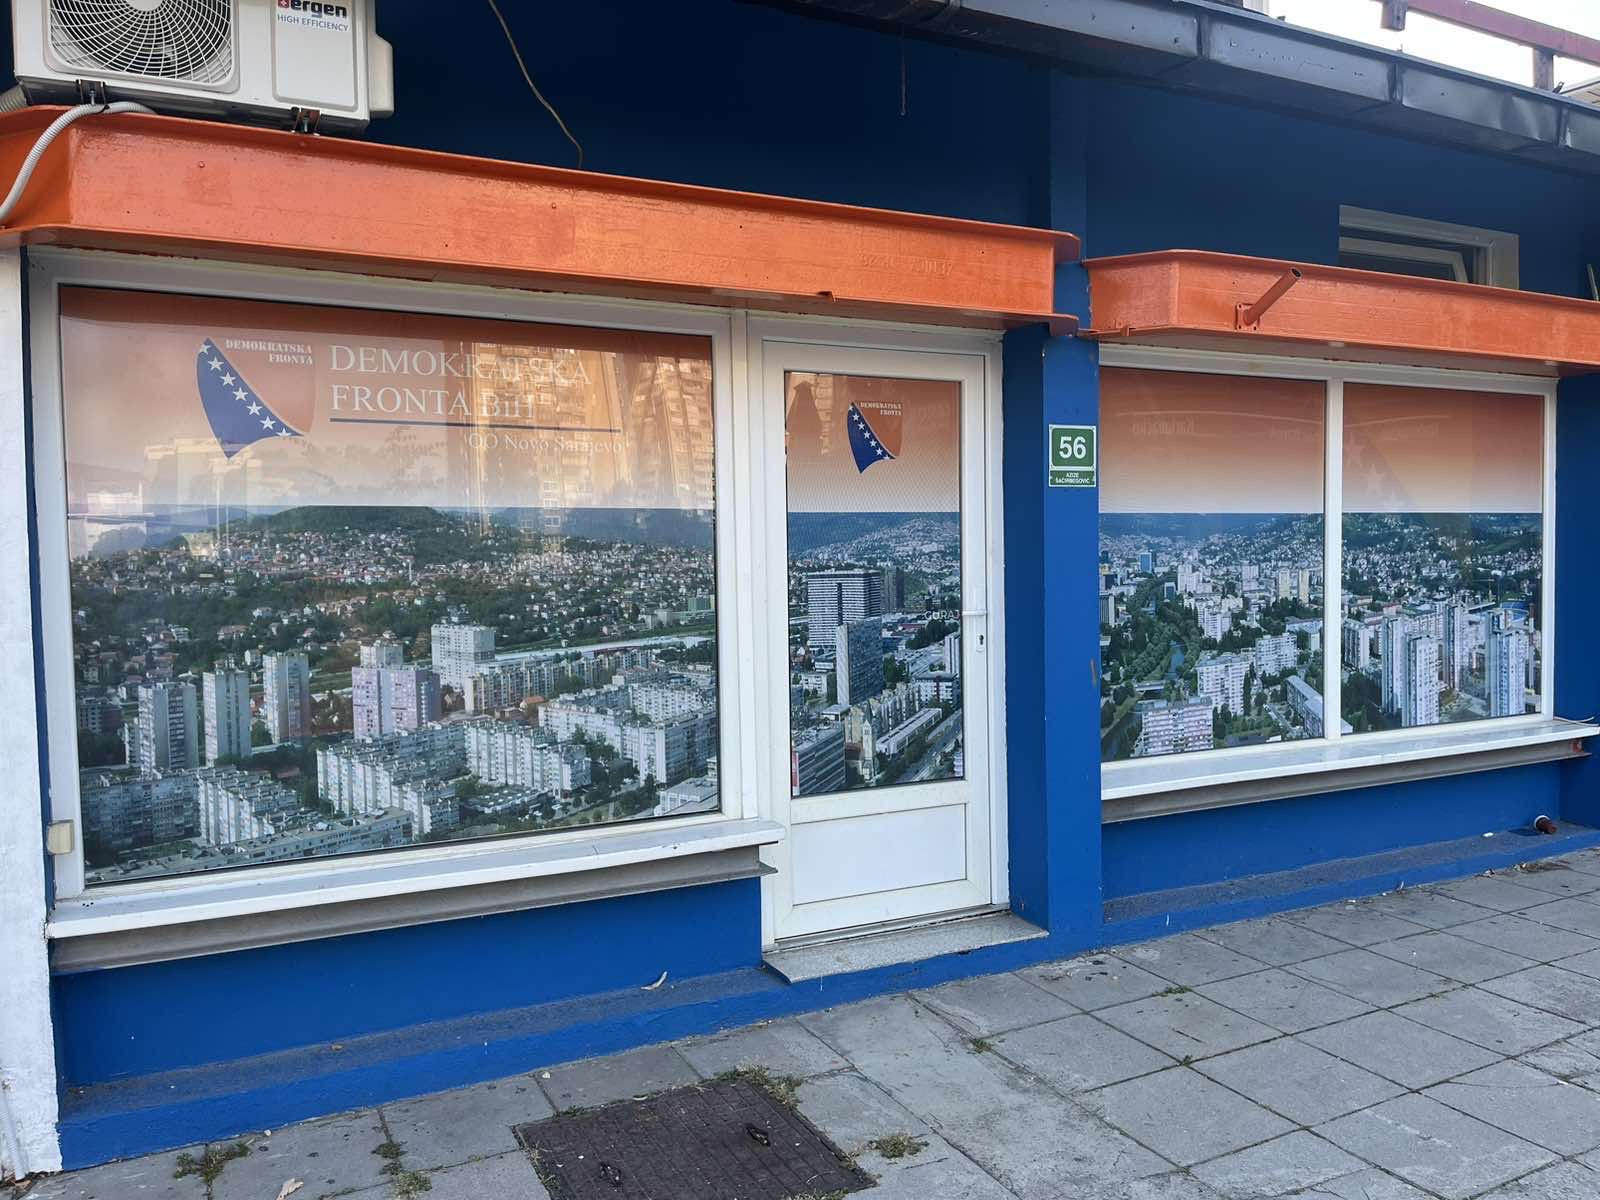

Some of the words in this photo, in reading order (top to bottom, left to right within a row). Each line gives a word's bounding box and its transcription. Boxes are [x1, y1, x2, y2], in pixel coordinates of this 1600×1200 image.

[277, 13, 300, 24] HIGH
[301, 17, 348, 31] EFFICIENCY
[225, 339, 312, 354] DEMOKRATSKA
[268, 353, 313, 365] FRONTA
[329, 344, 592, 386] DEMOKRATSKA
[330, 384, 472, 417] FRONTA
[504, 435, 550, 451] Novo
[1059, 436, 1087, 459] 56
